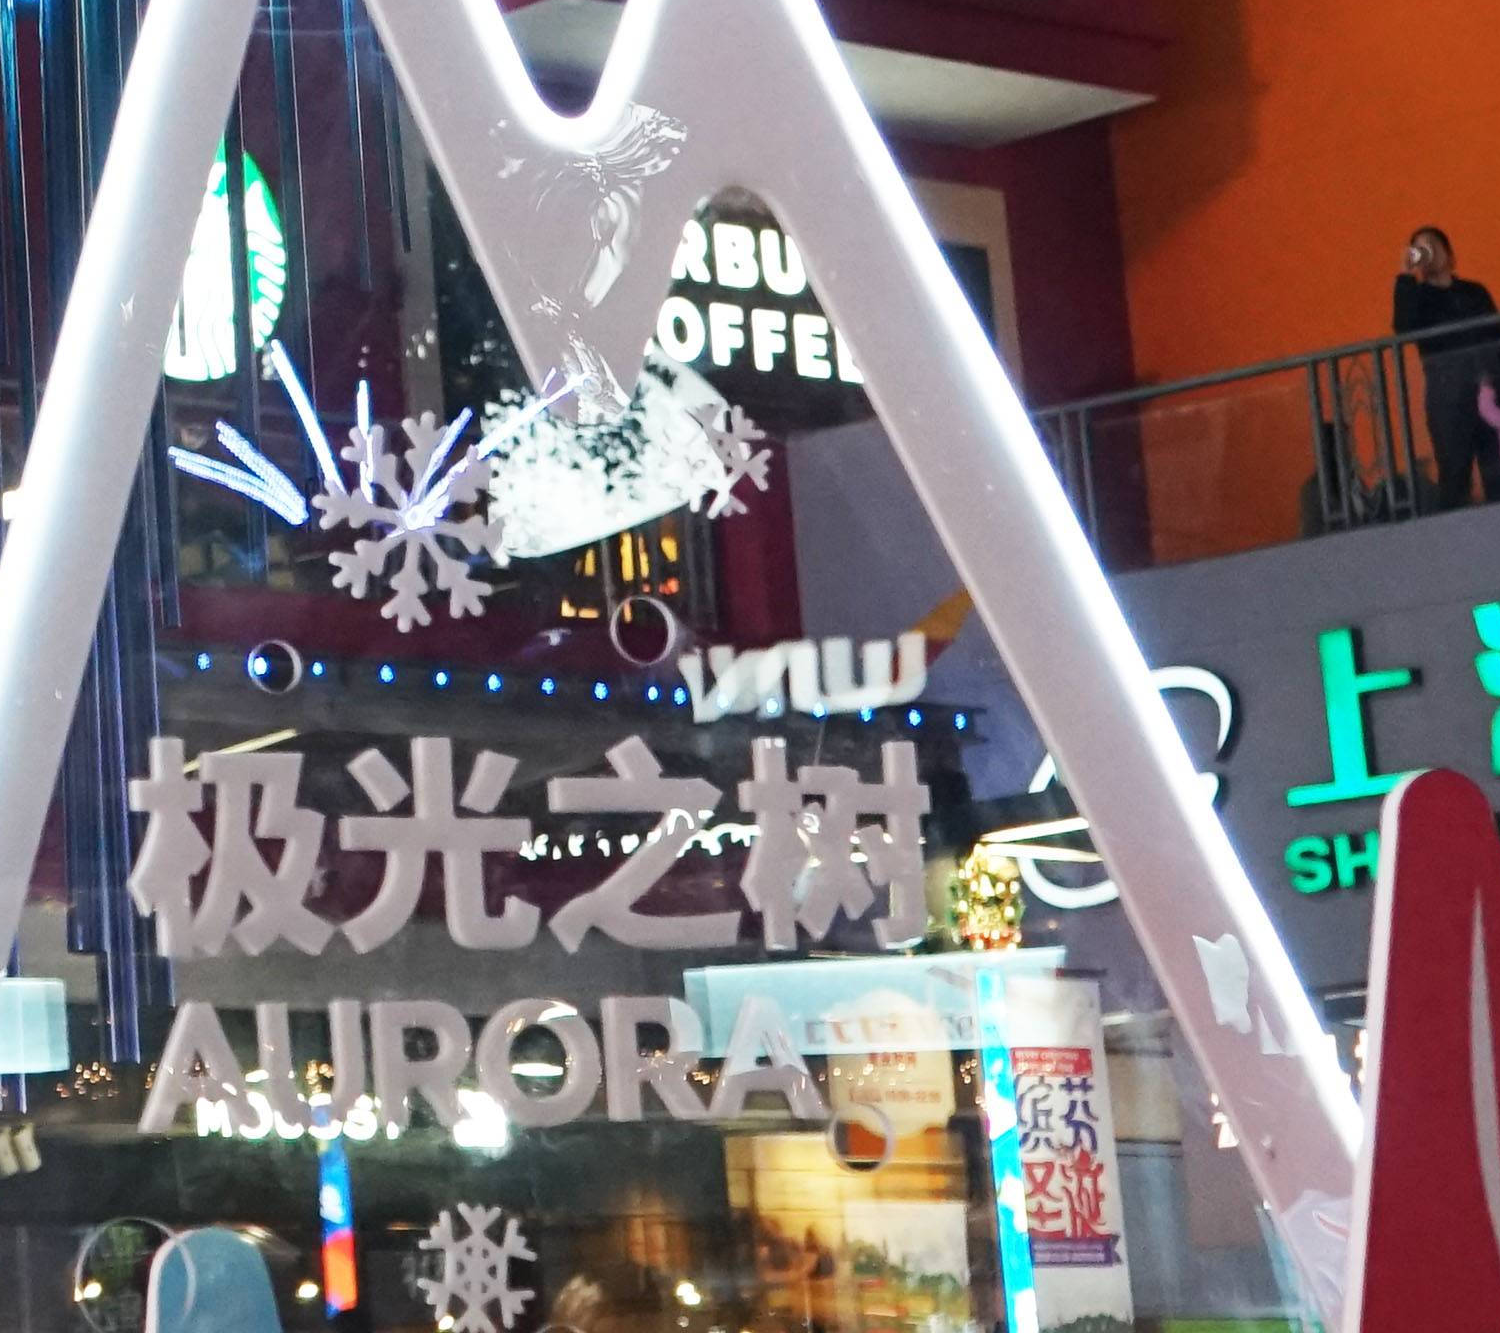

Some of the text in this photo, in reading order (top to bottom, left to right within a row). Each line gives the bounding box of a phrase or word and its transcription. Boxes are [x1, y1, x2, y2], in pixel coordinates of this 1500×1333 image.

[644, 296, 865, 384] OFFE
[127, 735, 932, 959] 极光之树
[138, 995, 834, 1134] AURORA
